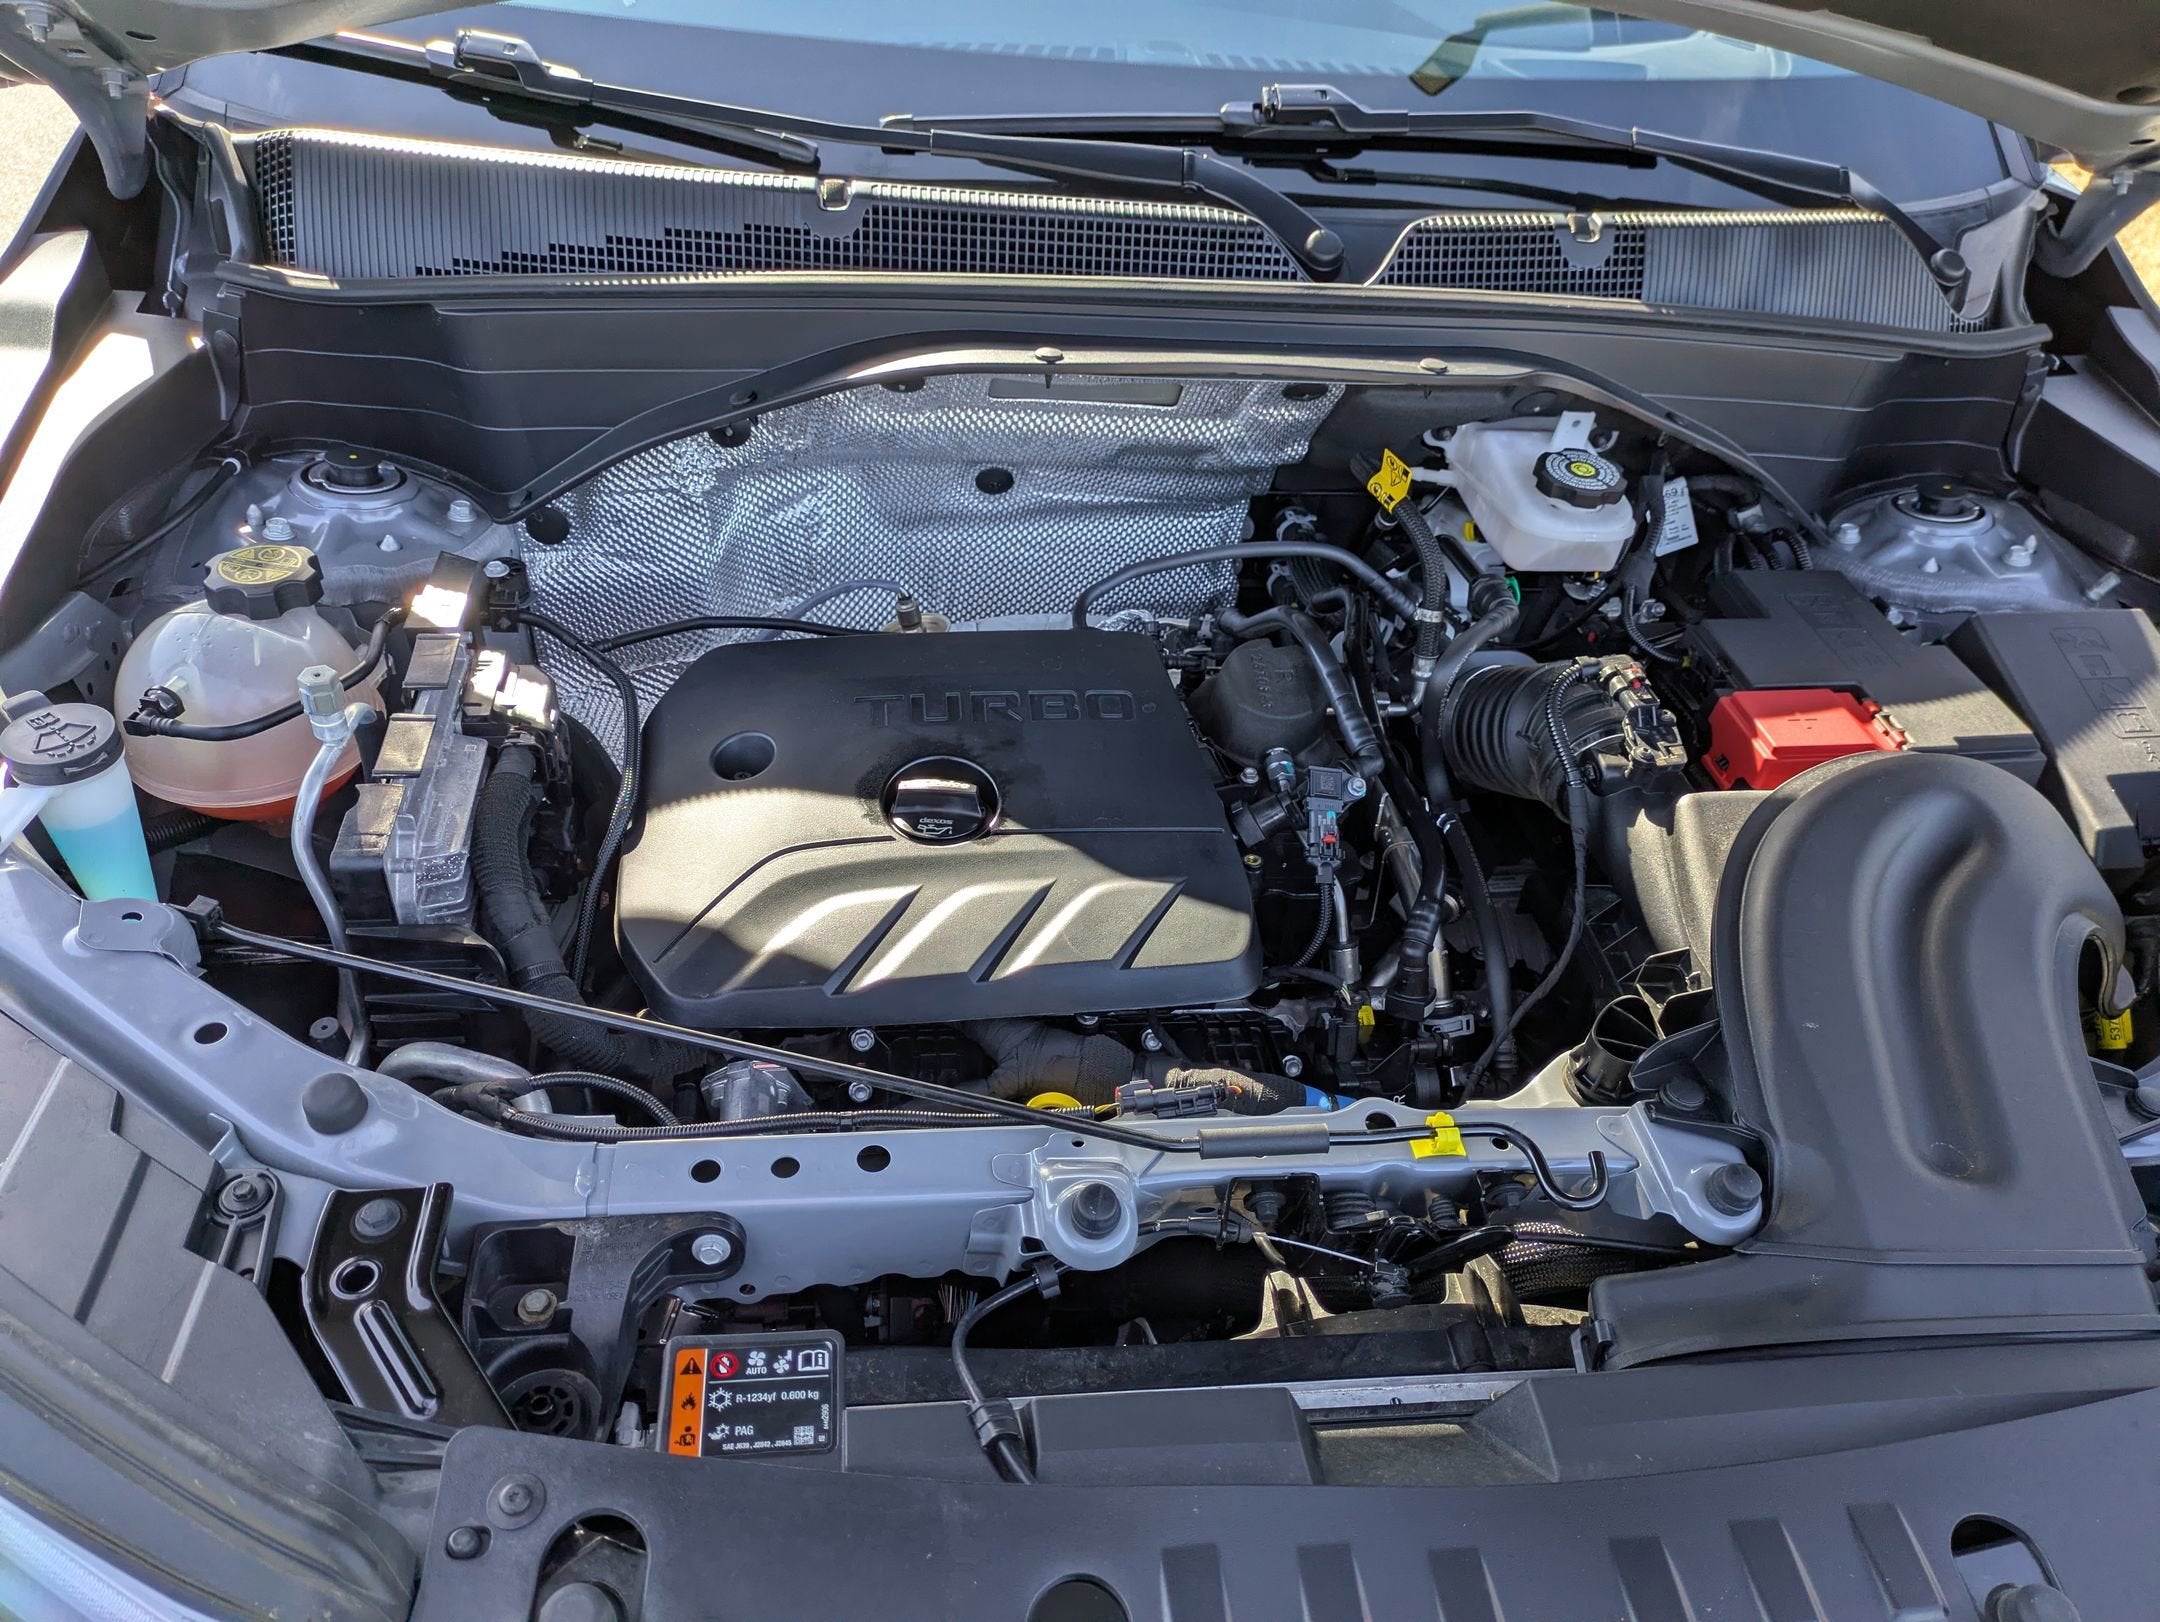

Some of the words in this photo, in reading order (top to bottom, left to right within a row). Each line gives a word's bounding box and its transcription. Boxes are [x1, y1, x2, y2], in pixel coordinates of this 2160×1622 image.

[853, 690, 1136, 726] TURBO
[919, 817, 954, 825] dexos
[2110, 1021, 2120, 1041] 537
[745, 1367, 767, 1375] AUTO
[736, 1392, 777, 1403] R-1234yf
[781, 1390, 806, 1400] 0.600
[808, 1389, 819, 1400] kg
[735, 1425, 754, 1436] PAG
